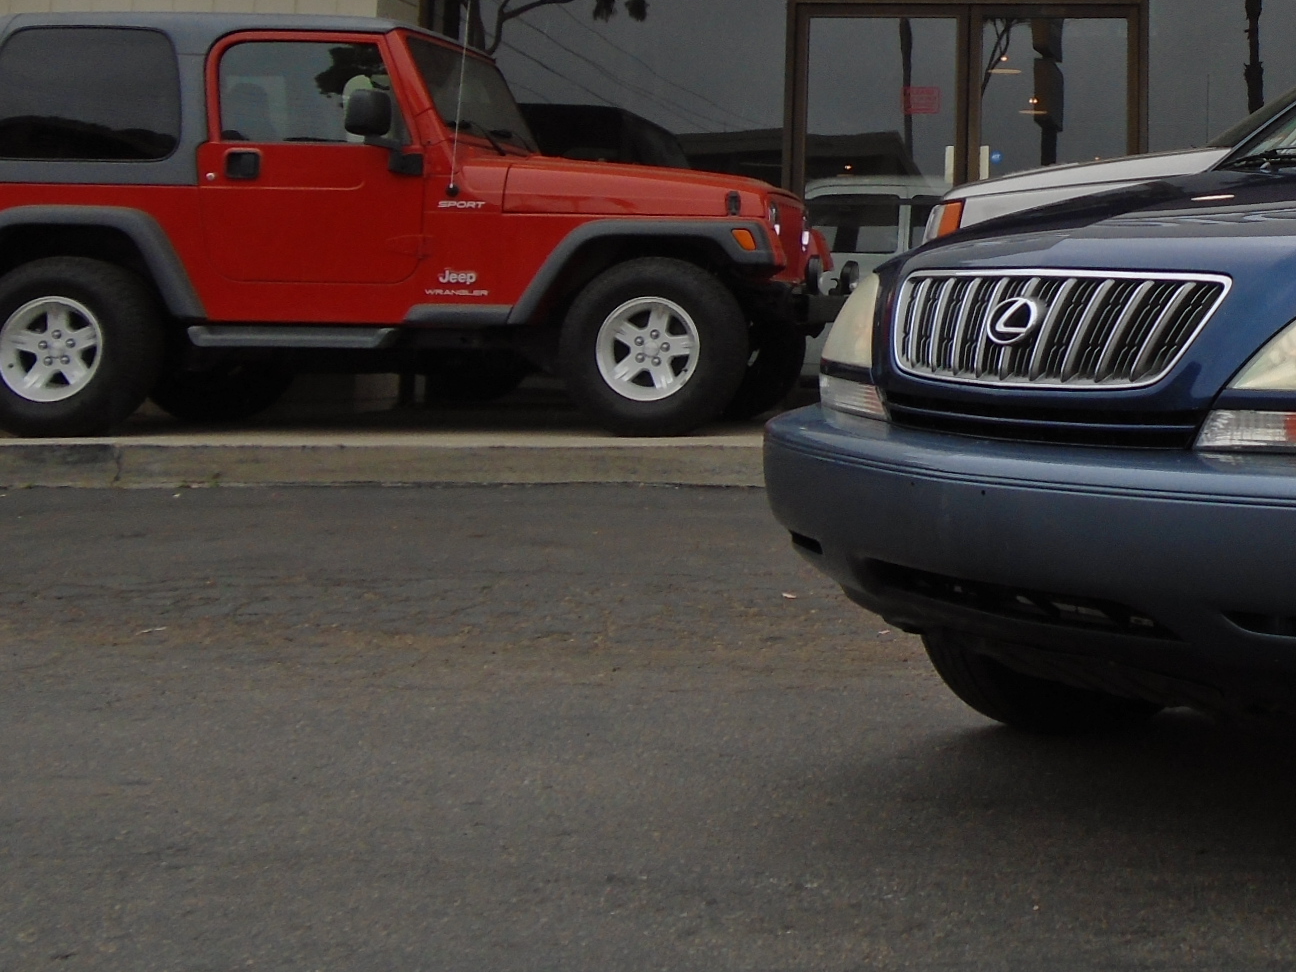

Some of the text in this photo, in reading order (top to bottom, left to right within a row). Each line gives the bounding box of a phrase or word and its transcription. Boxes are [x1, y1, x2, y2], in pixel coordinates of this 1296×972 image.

[437, 200, 486, 209] SPORT
[438, 269, 477, 285] Jeep
[424, 289, 489, 297] WRANGLER
